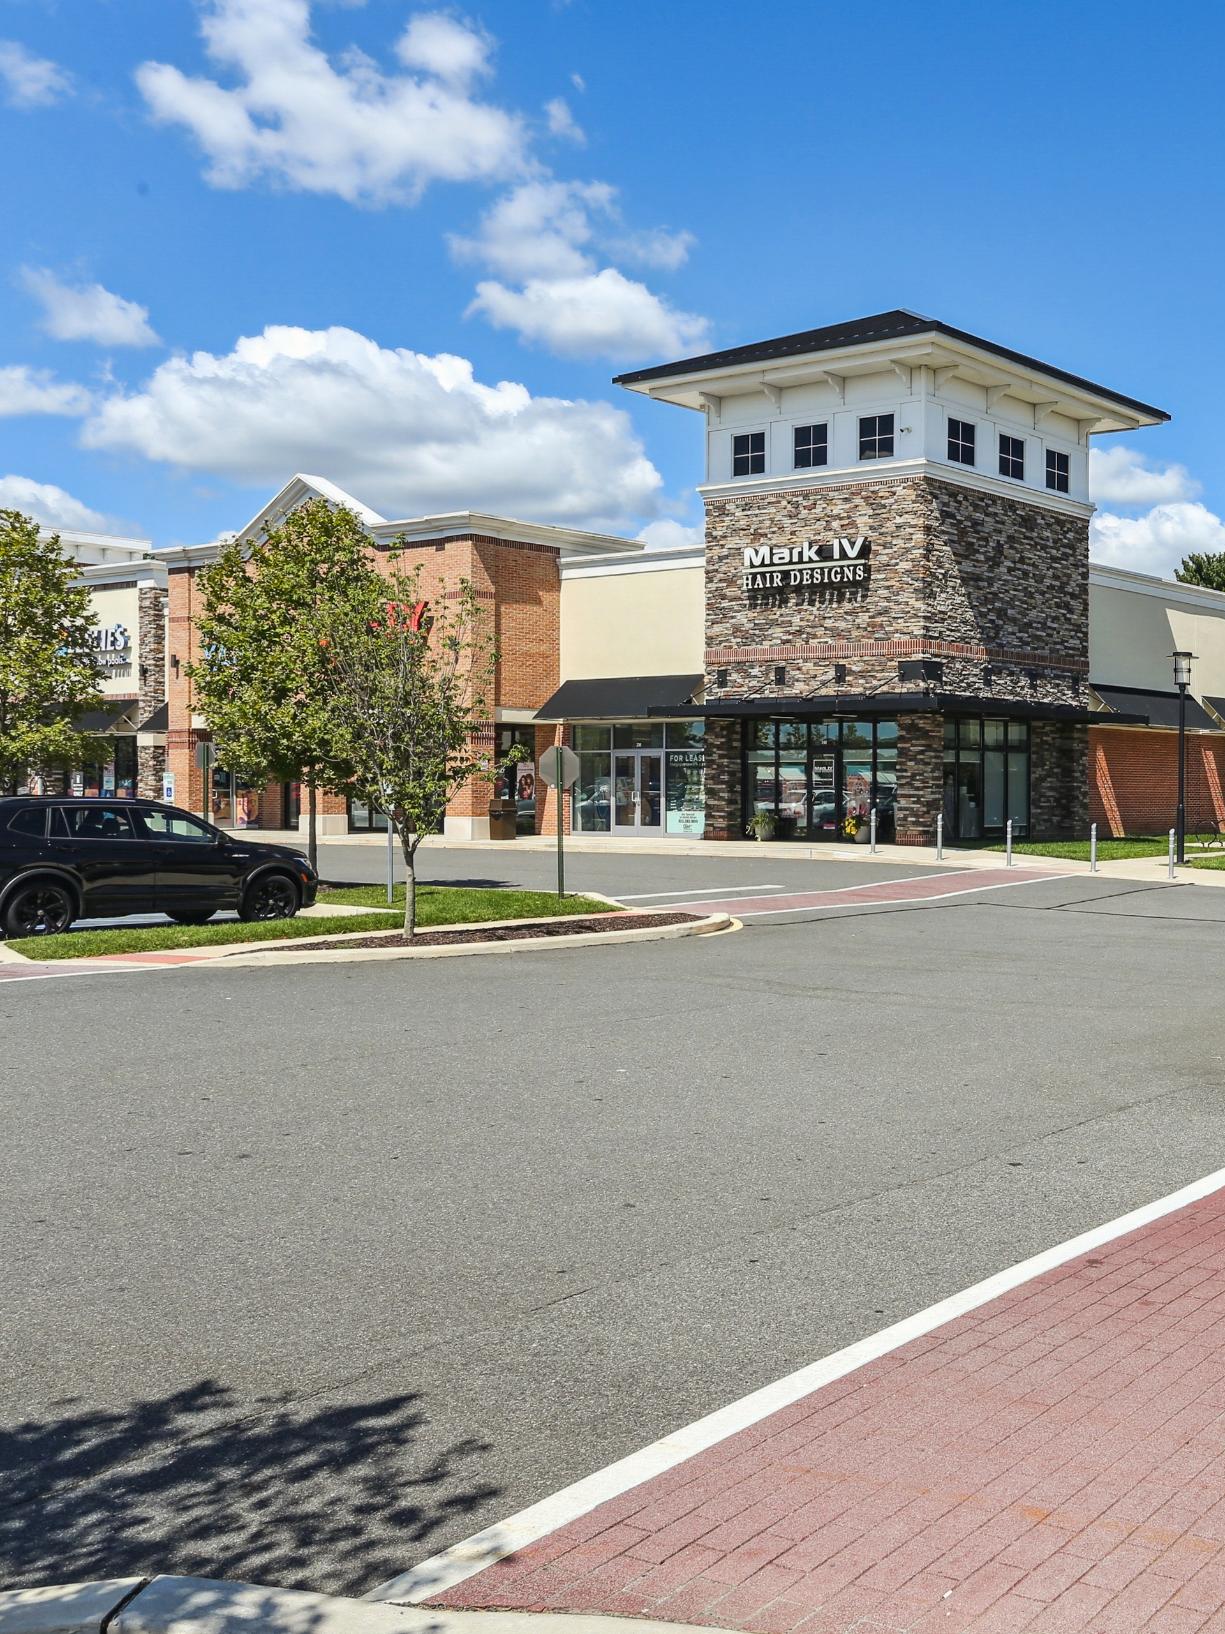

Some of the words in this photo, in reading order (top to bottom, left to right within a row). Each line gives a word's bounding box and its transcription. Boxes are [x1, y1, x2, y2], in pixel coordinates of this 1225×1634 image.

[743, 541, 820, 568] Mark
[833, 537, 865, 560] IV
[742, 572, 783, 589] HAIR
[790, 565, 864, 585] DESIGNS
[669, 754, 683, 762] FOR
